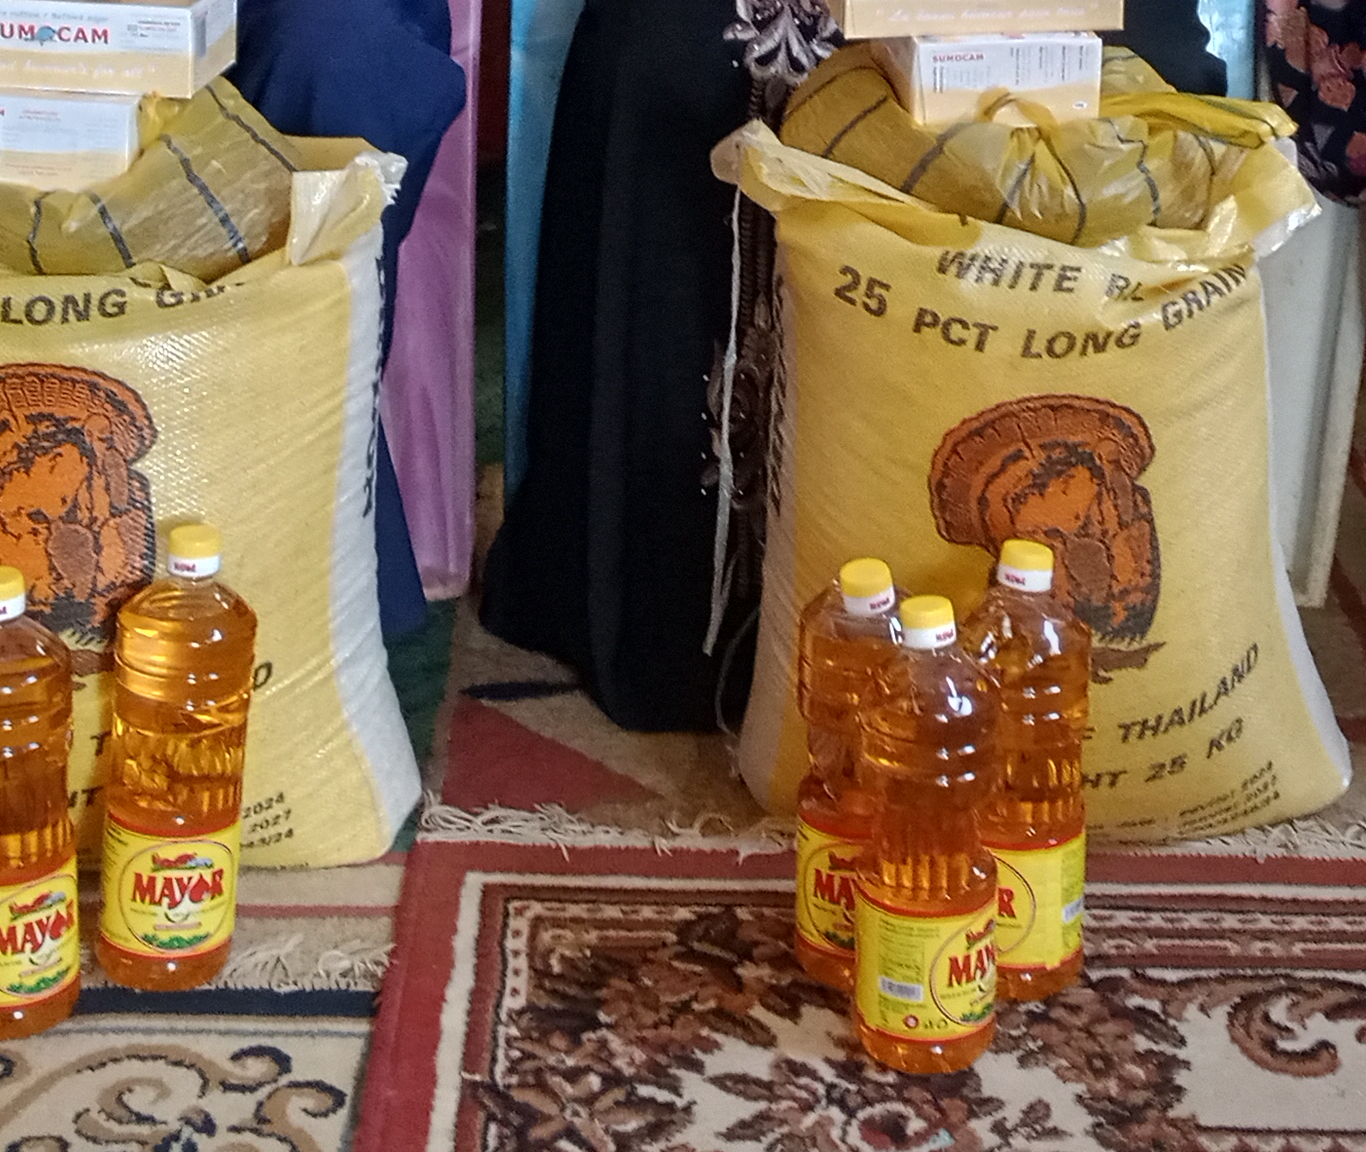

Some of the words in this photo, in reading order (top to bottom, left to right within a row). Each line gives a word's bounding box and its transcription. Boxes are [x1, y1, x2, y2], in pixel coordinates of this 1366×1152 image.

[937, 249, 1082, 295] WHITE
[1, 288, 128, 326] LONG
[834, 264, 891, 317] 25
[912, 307, 999, 354] PCT
[1020, 320, 1142, 360] LONG
[1161, 263, 1247, 331] GRAIN
[1118, 642, 1259, 744] THAILAND
[1145, 753, 1187, 783] 25
[131, 868, 224, 909] MAYOR
